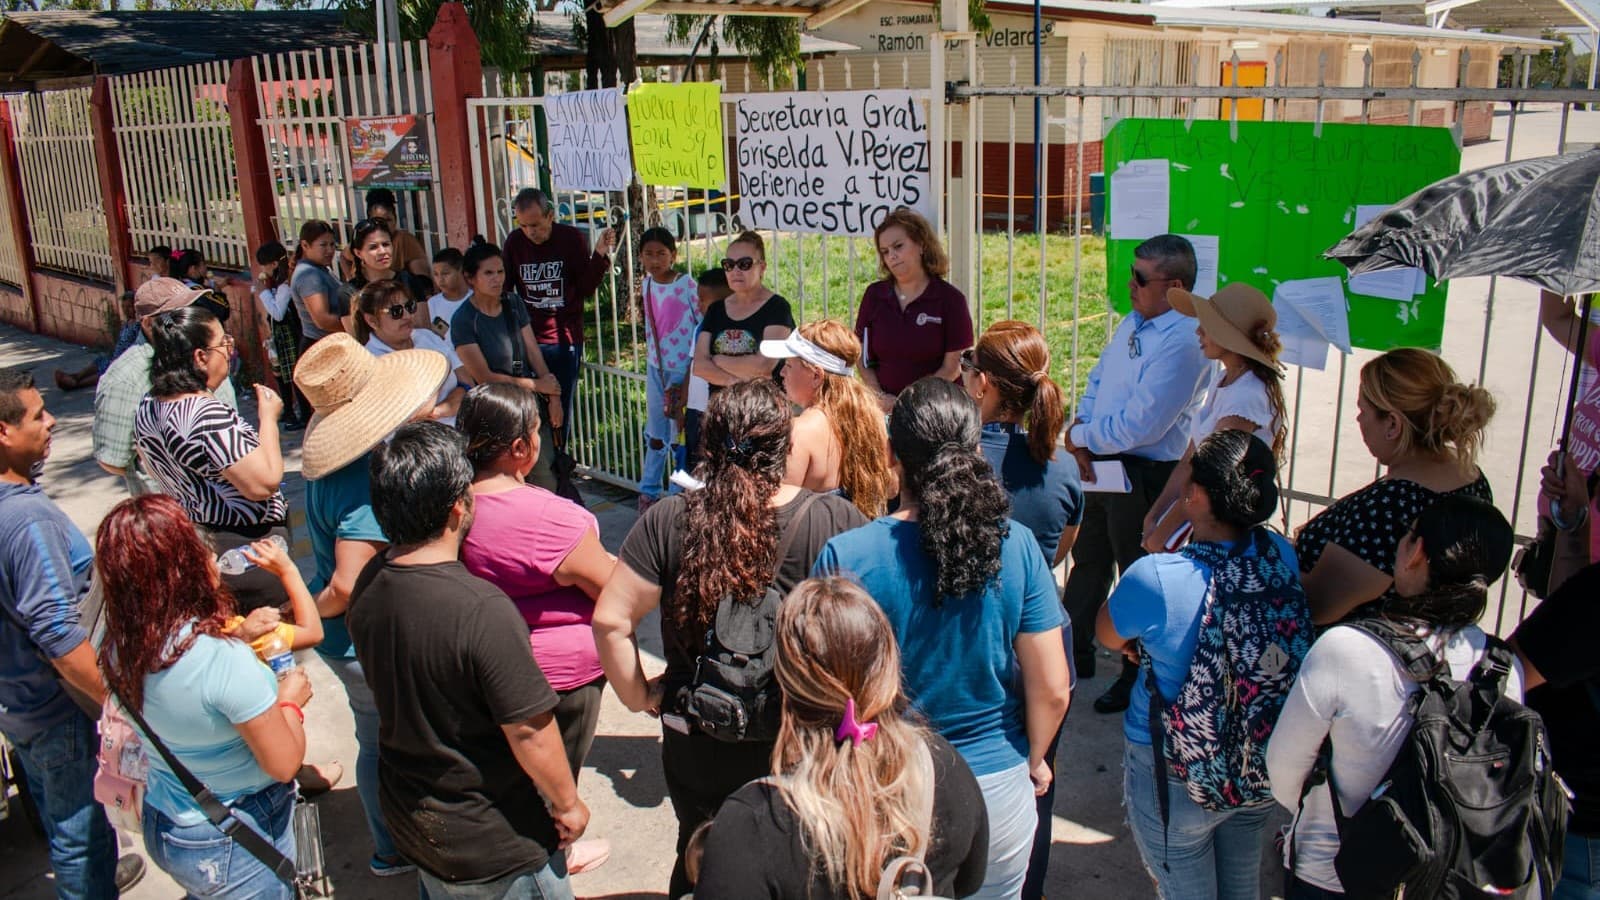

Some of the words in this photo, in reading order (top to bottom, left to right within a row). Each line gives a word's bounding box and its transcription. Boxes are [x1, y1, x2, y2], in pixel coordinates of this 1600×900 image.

[897, 14, 933, 25] PRIMARIA
[683, 89, 698, 126] de
[702, 89, 719, 134] la
[738, 96, 848, 134] Secretaria
[863, 94, 927, 132] Gral.
[550, 123, 616, 152] ZAVALA
[738, 134, 828, 169] Griselda
[740, 170, 825, 198] Defiende
[845, 176, 860, 195] a
[868, 171, 920, 205] tus
[749, 194, 909, 234] maestra
